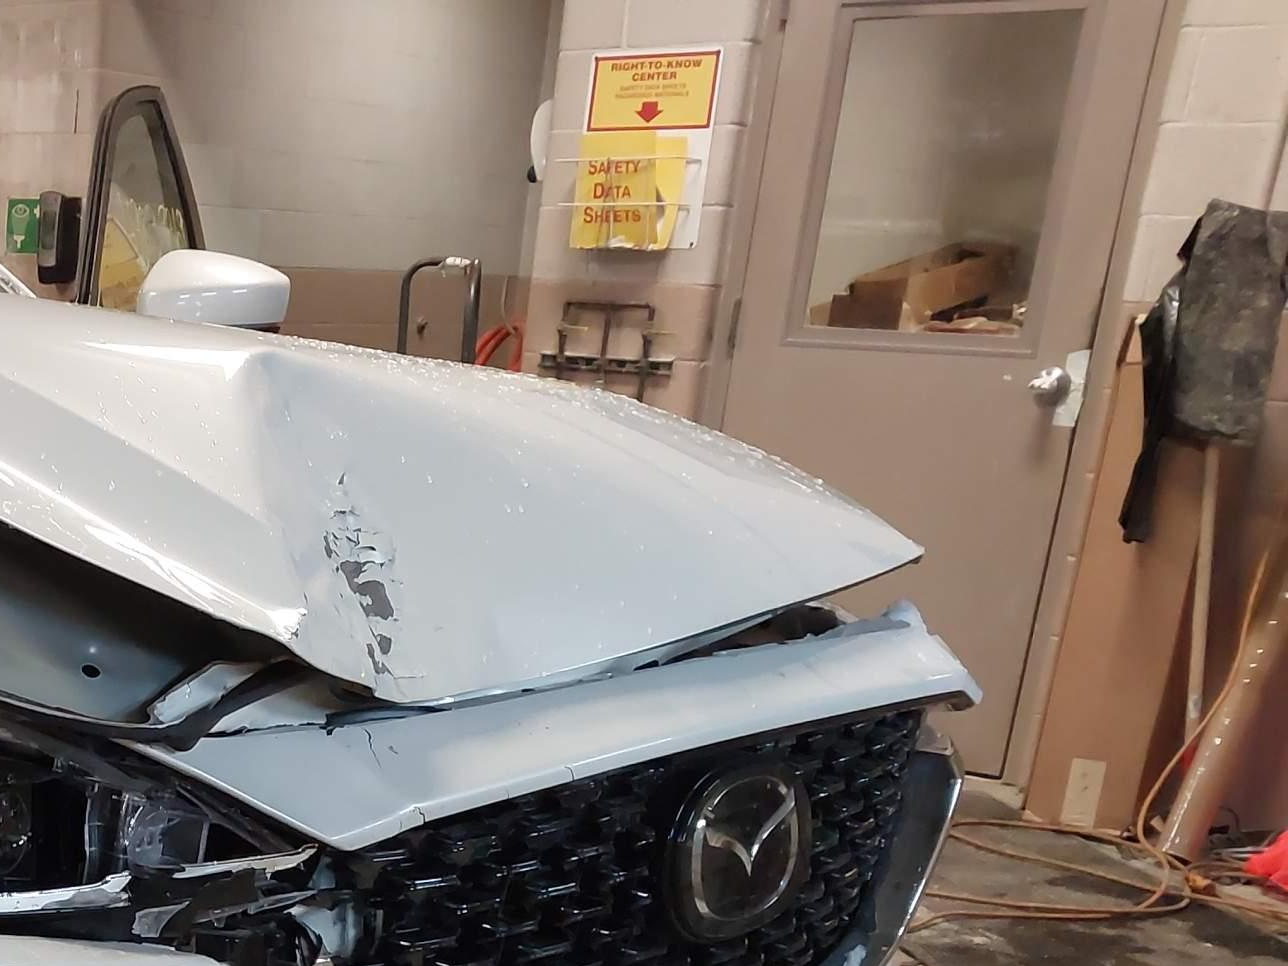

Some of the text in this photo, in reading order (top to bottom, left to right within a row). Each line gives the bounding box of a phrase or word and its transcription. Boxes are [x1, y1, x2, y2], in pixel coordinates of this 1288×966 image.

[611, 59, 702, 72] RIGHT-TO-KNOW
[631, 71, 677, 82] CENTER
[588, 159, 641, 175] SAFETY
[593, 182, 631, 199] DATA
[584, 206, 641, 224] SHEETS
